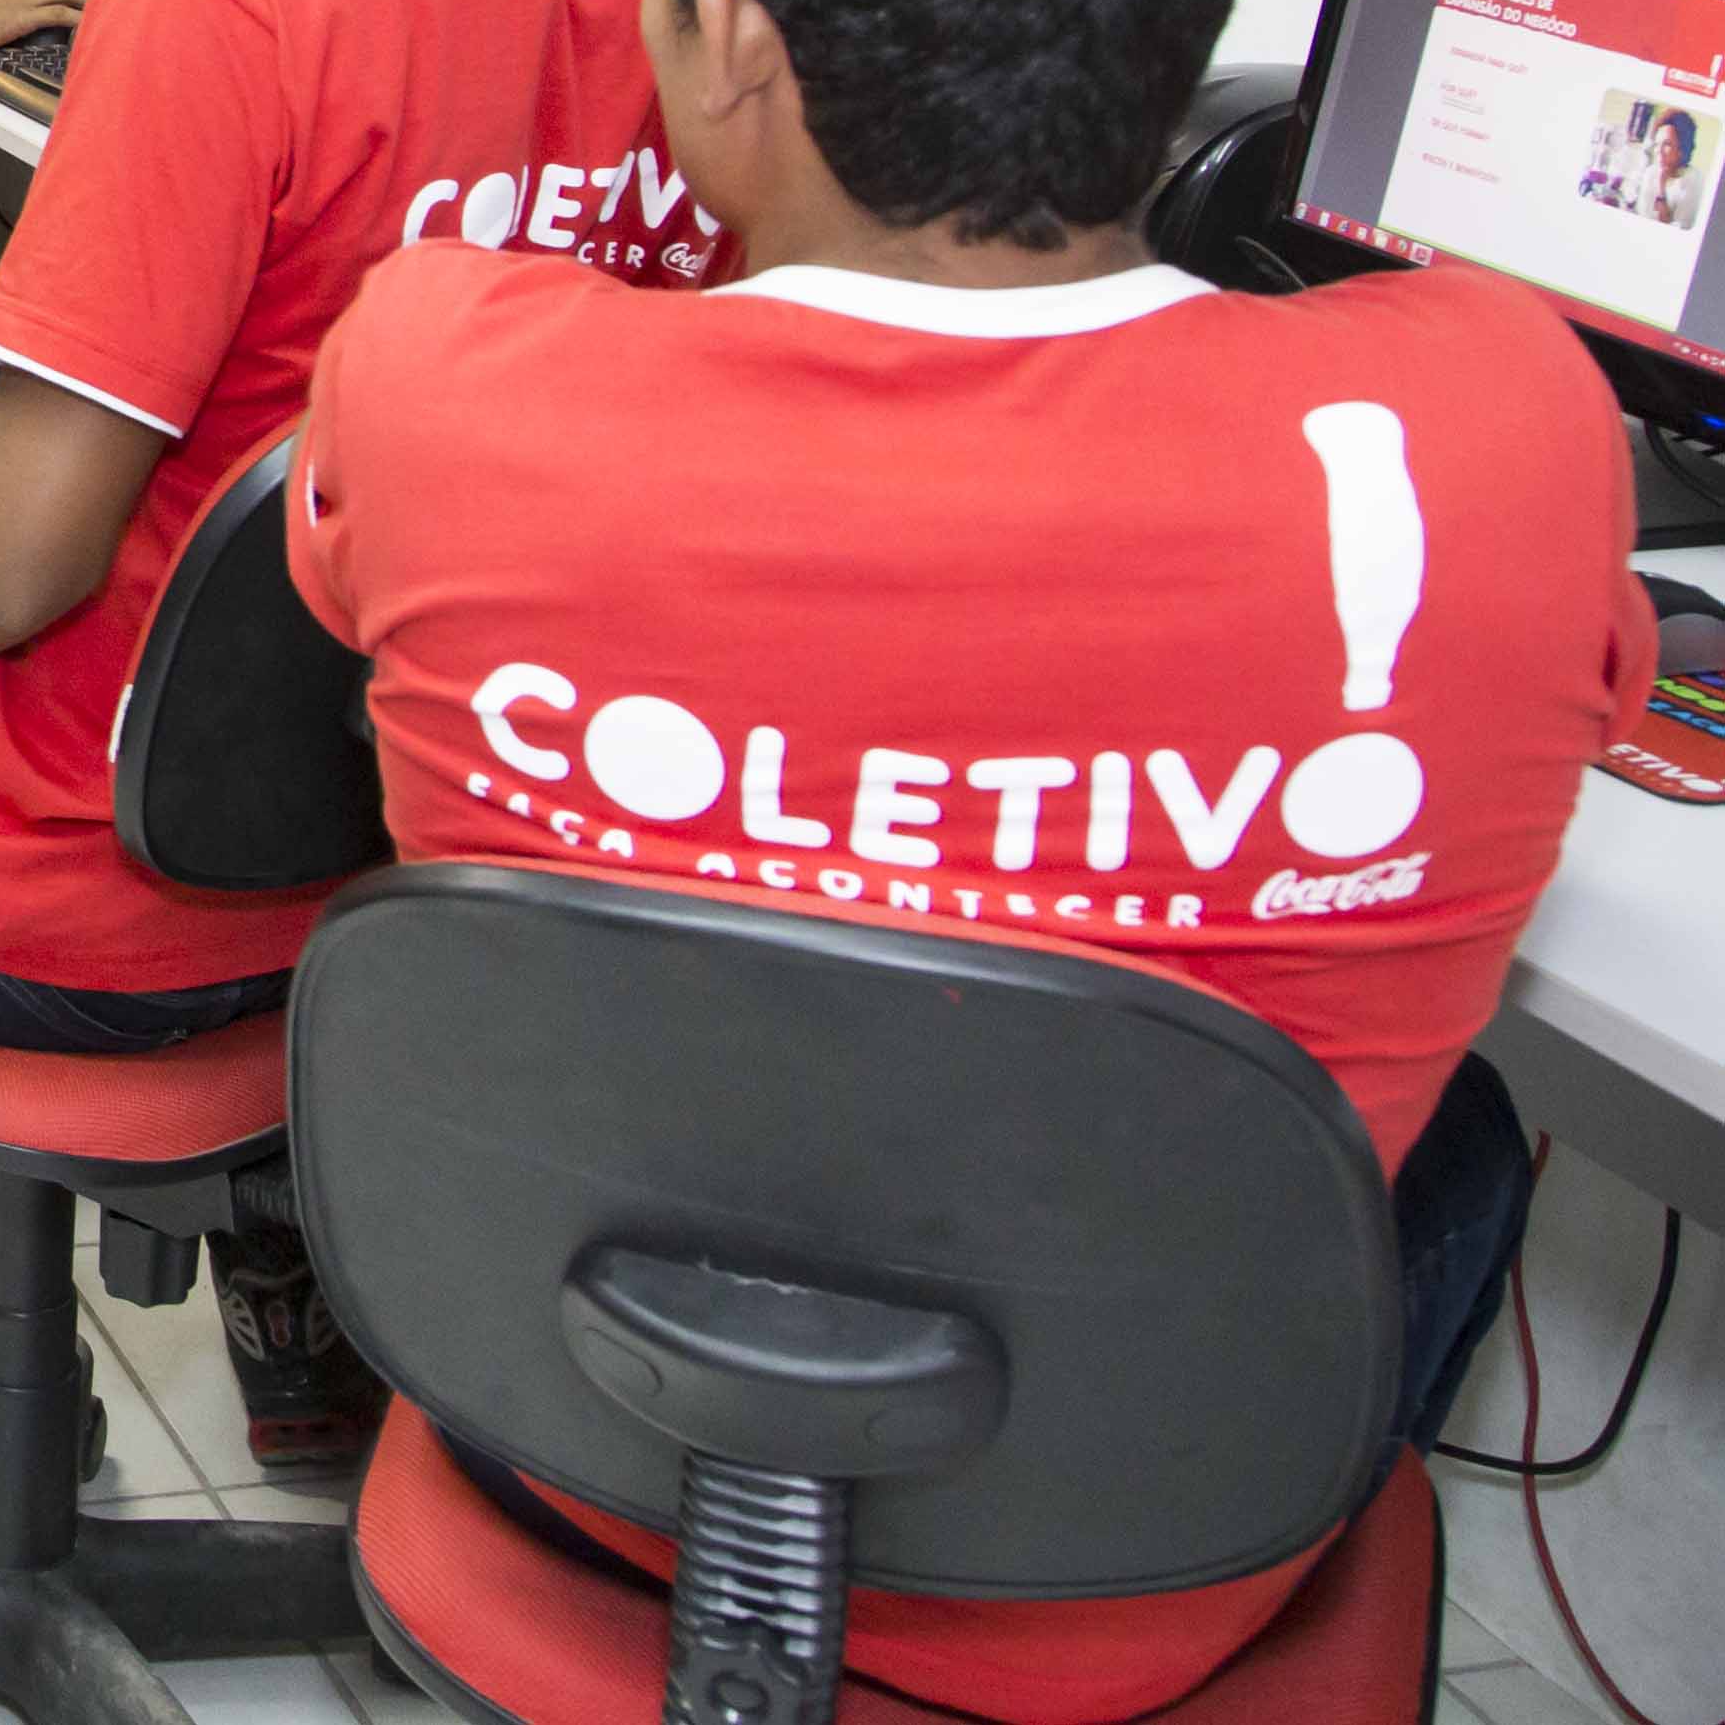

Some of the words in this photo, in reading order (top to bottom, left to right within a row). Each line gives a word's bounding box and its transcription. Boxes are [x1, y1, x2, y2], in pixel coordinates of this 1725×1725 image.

[1502, 6, 1523, 23] DO
[469, 660, 1425, 874] COLETIVO
[466, 771, 634, 859] FAÇA
